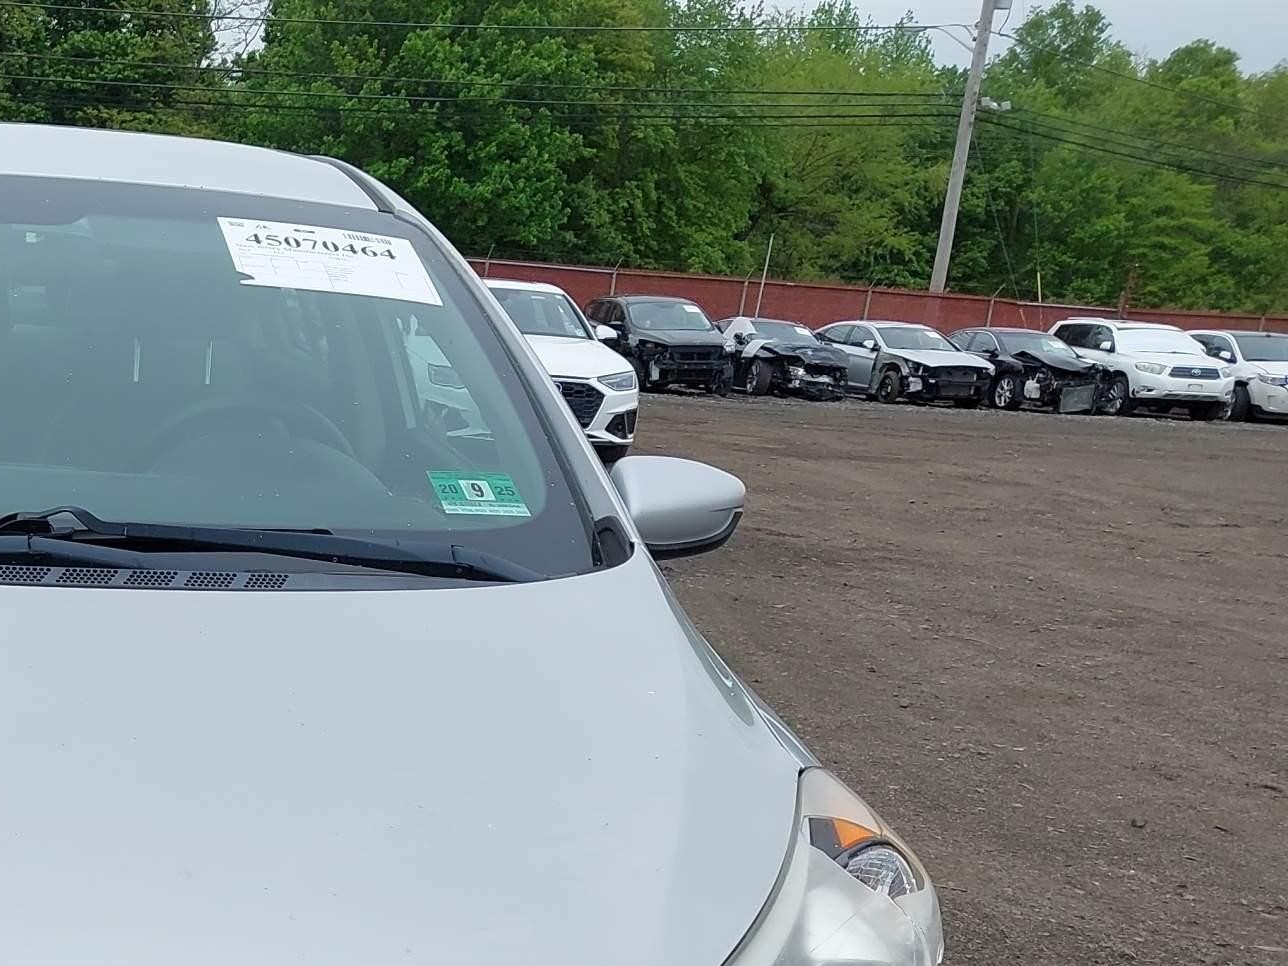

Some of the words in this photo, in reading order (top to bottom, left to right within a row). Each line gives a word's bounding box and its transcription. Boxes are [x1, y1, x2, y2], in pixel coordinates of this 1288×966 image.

[245, 233, 397, 261] 45070464
[438, 484, 458, 494] 20
[470, 482, 485, 498] 9
[494, 486, 516, 497] 25
